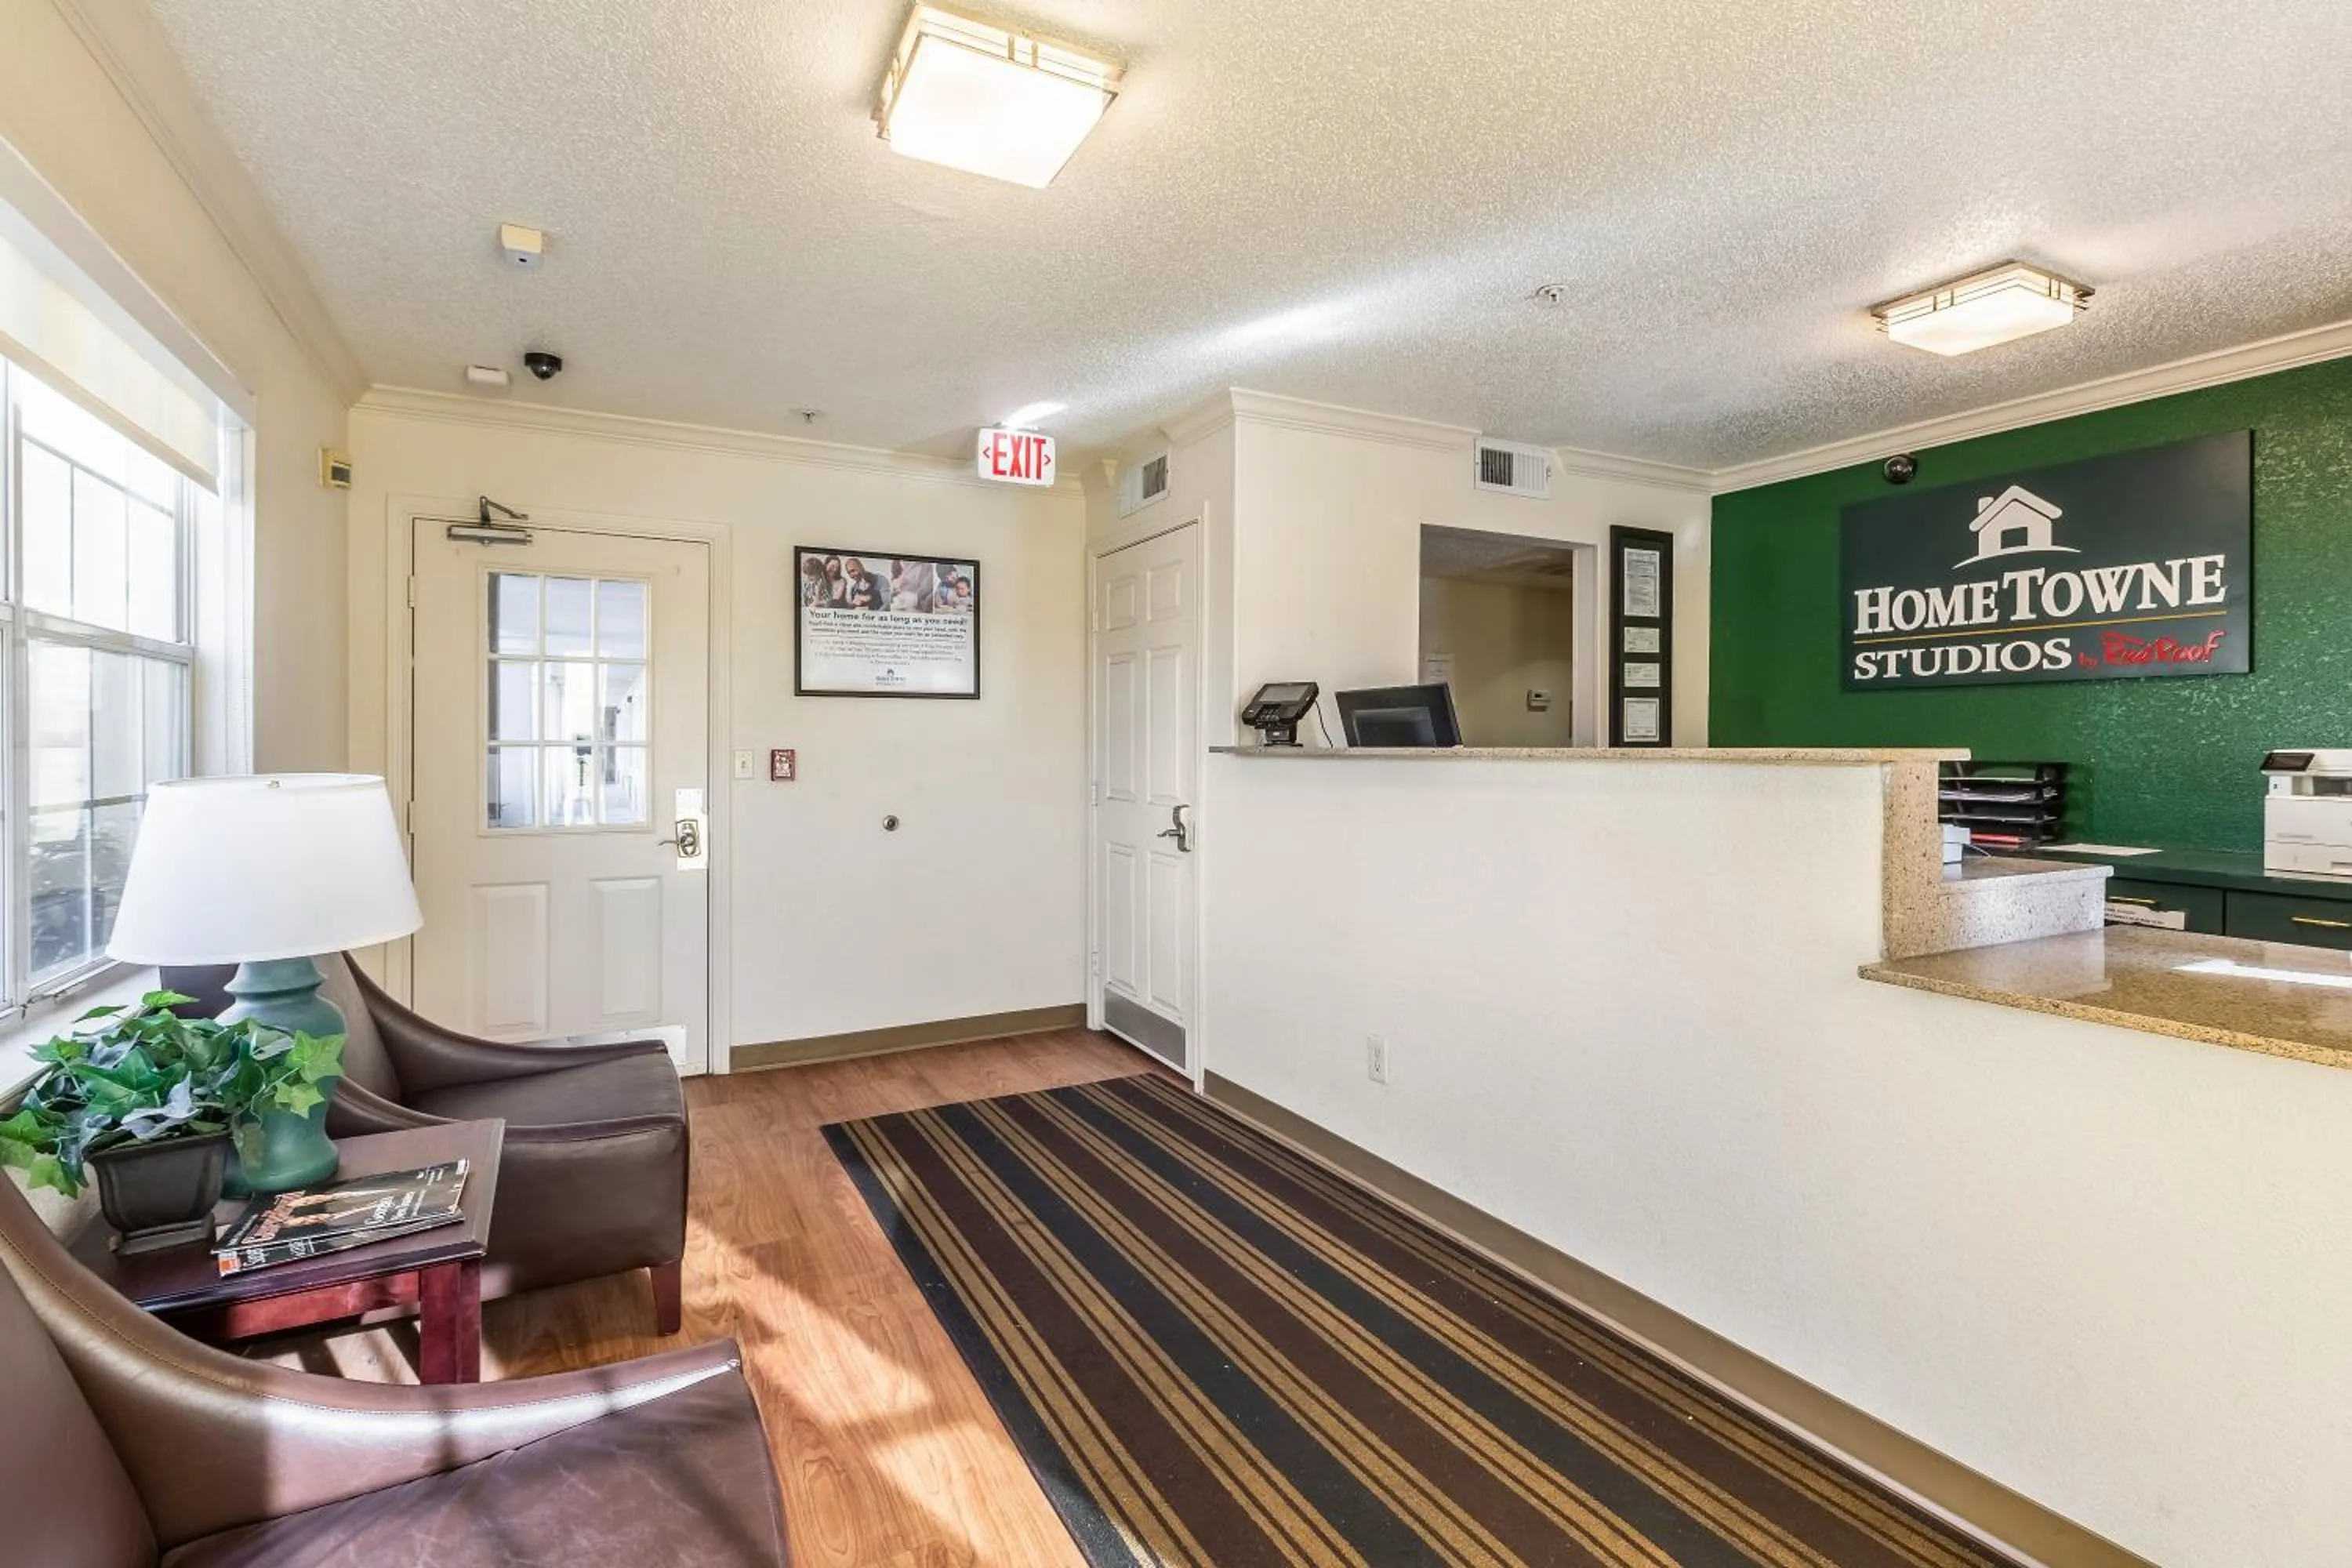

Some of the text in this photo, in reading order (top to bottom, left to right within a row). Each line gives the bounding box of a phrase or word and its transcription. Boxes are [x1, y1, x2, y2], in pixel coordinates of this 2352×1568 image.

[993, 433, 1047, 480] EXIT
[810, 610, 831, 619] Your
[833, 611, 859, 620] home
[862, 612, 875, 621] for
[891, 615, 909, 624] long
[1853, 630, 2227, 681] STUDIOS by Red Roof
